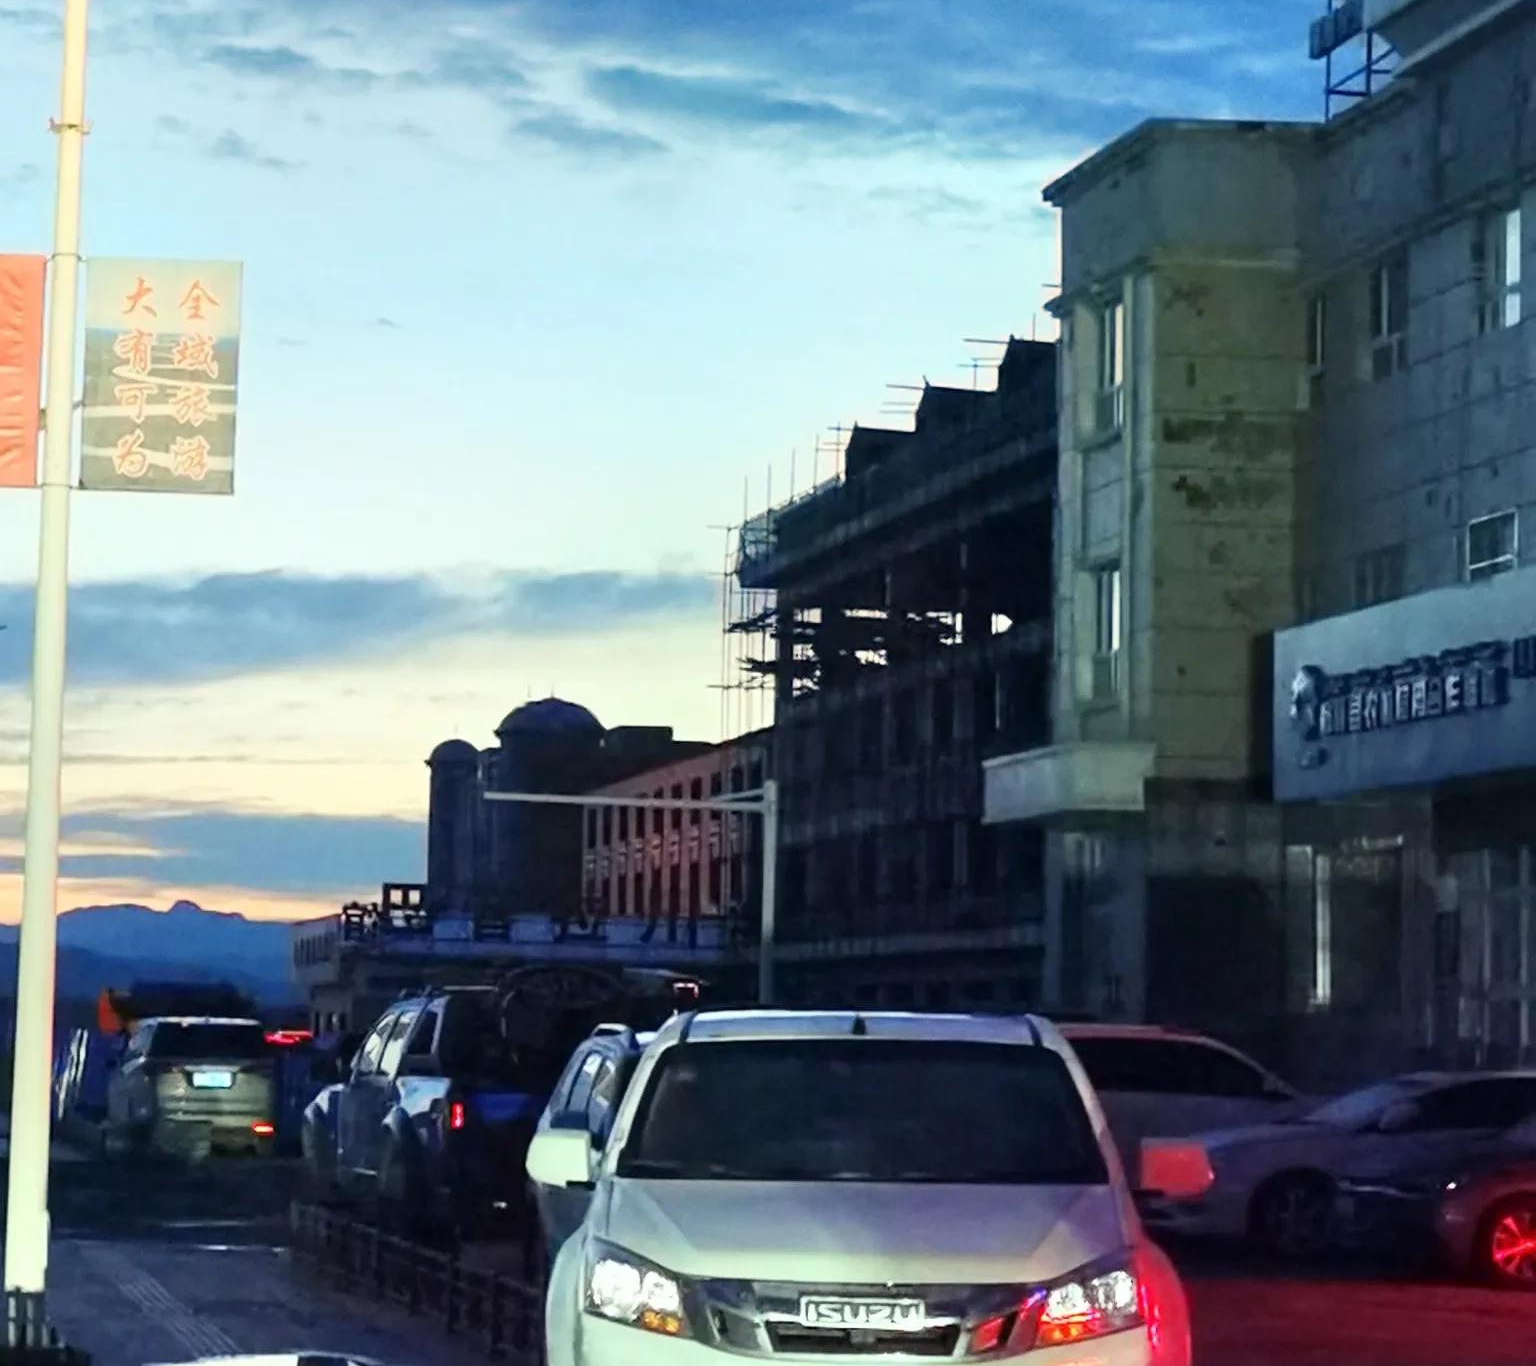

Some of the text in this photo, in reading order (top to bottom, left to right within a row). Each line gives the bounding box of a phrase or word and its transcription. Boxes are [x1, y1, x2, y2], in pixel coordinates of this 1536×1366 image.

[111, 276, 159, 479] 大有可为
[169, 278, 220, 481] 全域旅游
[807, 1302, 919, 1323] ISUZU
